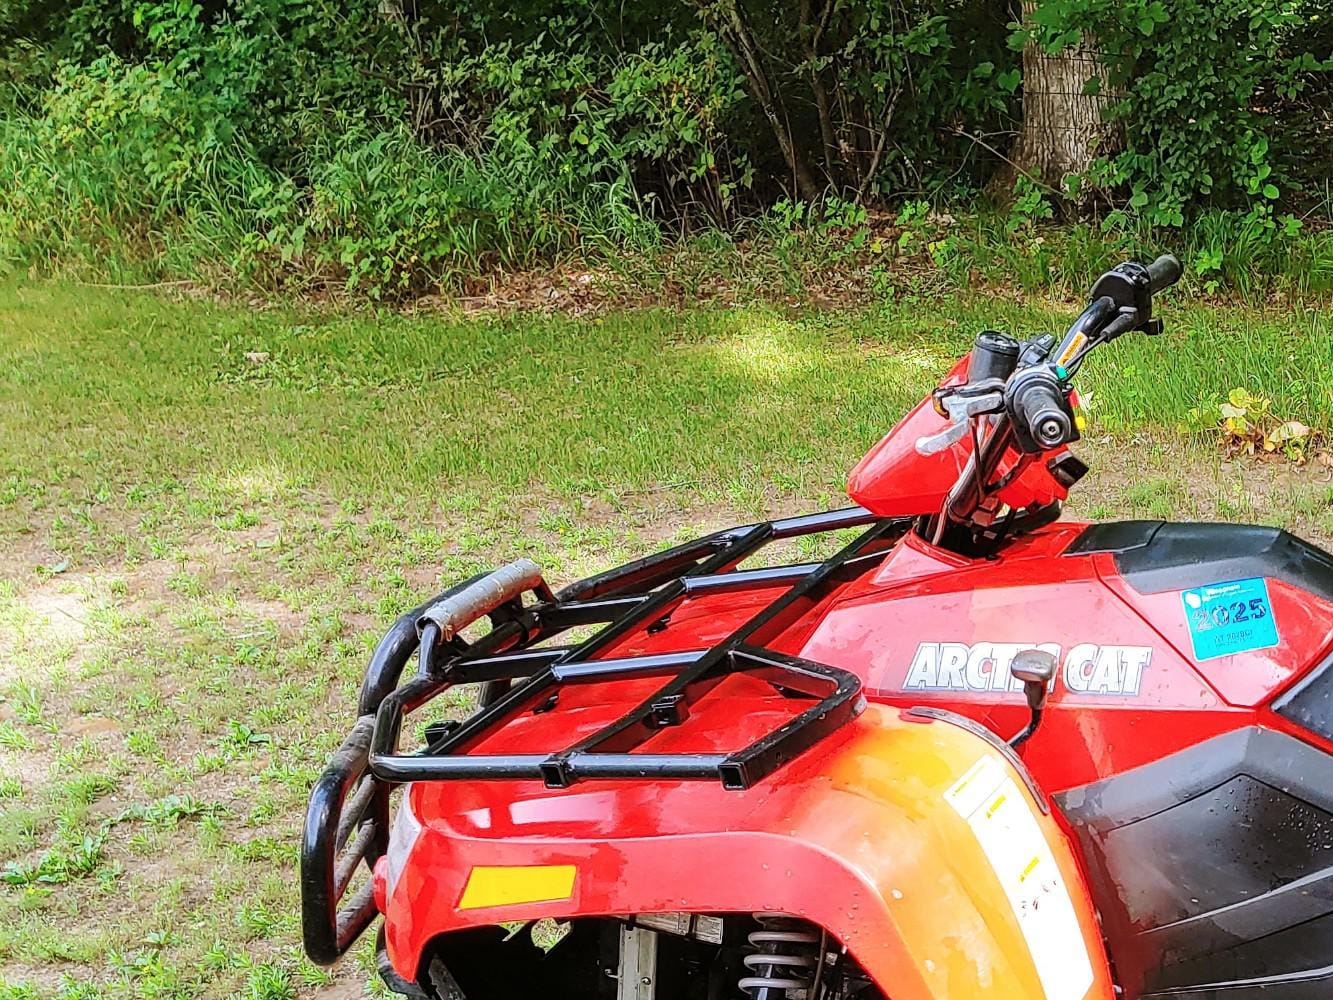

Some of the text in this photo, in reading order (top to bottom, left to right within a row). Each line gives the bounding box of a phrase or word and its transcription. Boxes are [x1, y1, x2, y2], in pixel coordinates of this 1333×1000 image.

[1192, 598, 1267, 632] 2025
[903, 642, 1153, 697] ARCT CAT
